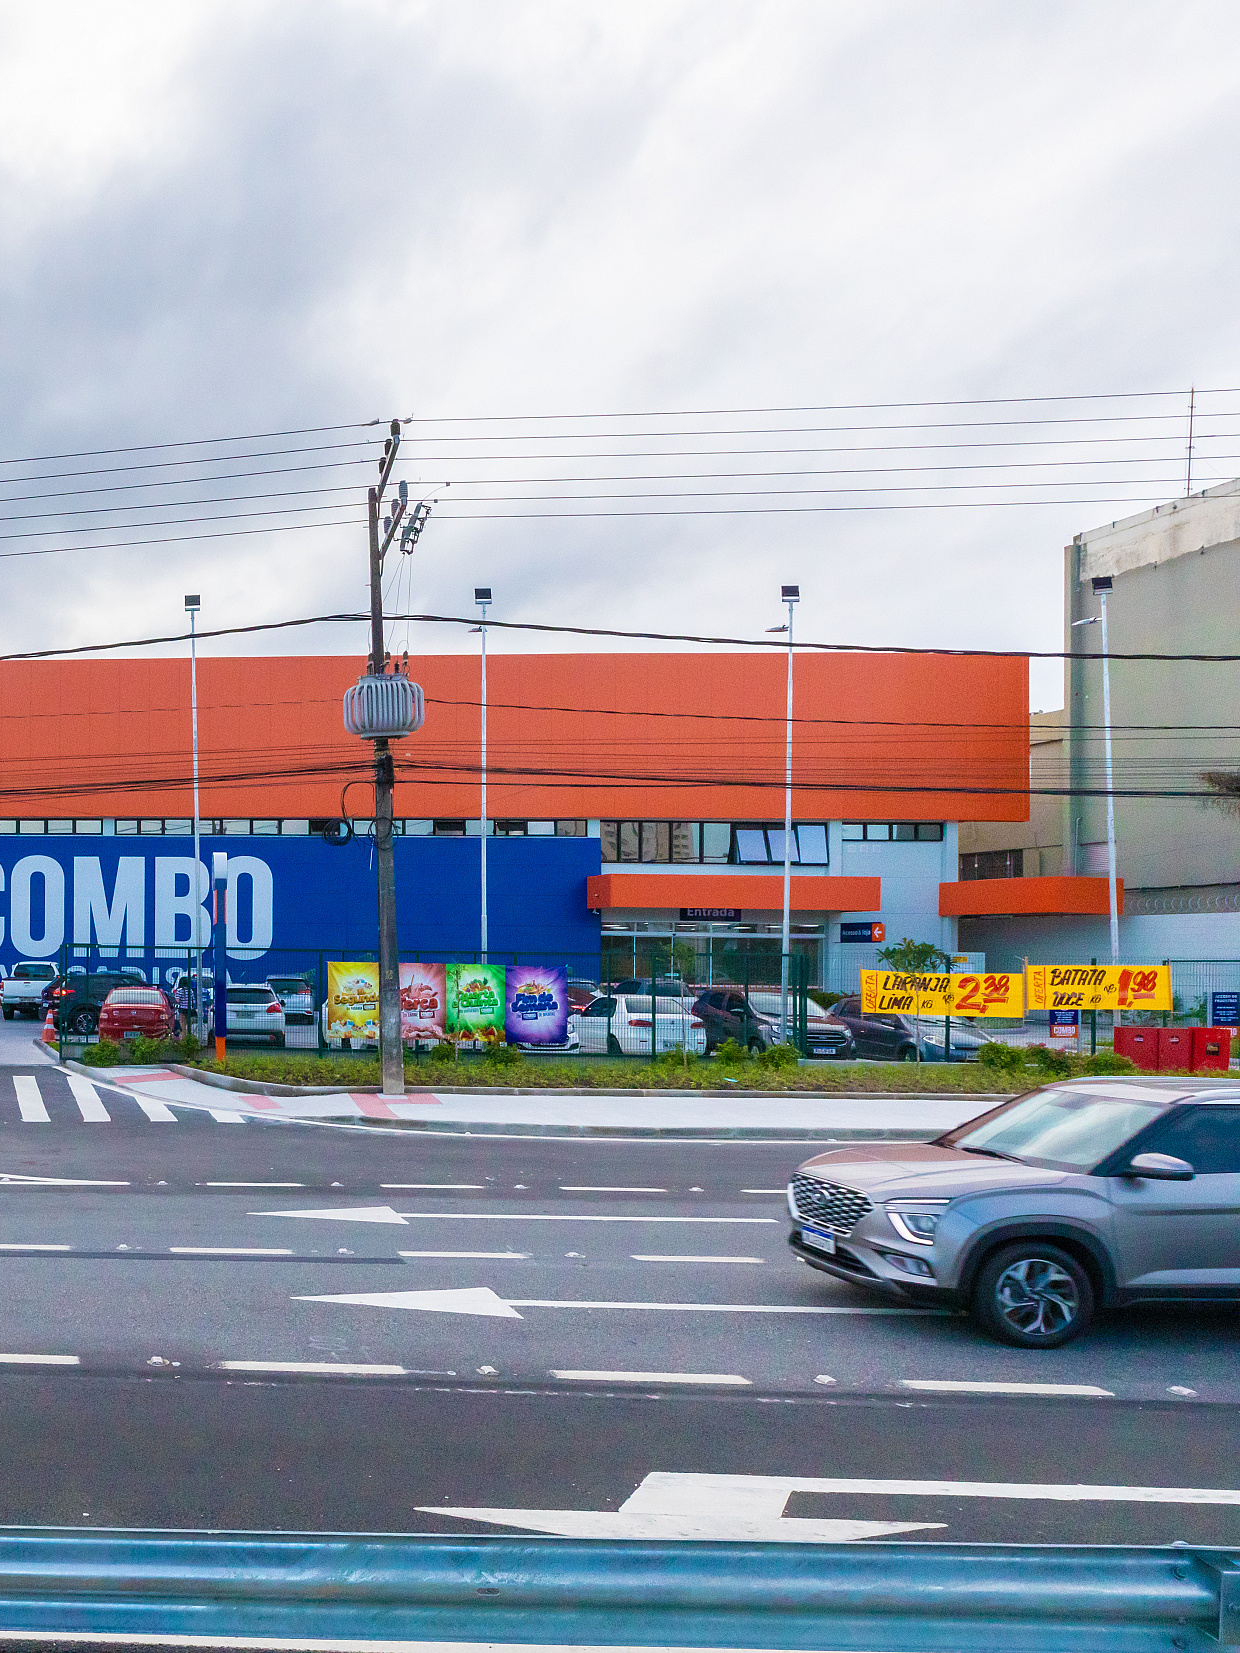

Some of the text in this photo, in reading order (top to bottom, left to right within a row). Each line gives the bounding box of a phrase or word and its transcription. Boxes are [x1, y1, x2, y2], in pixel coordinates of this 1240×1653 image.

[687, 907, 735, 917] Entrada
[882, 975, 950, 993] LARANJA
[1050, 968, 1106, 986] BATATA
[865, 974, 876, 1009] OFERTA
[1033, 971, 1043, 1004] OFERTA
[333, 992, 379, 1006] Segund
[1052, 991, 1085, 1007] DOCE
[1054, 1026, 1076, 1034] COMBO
